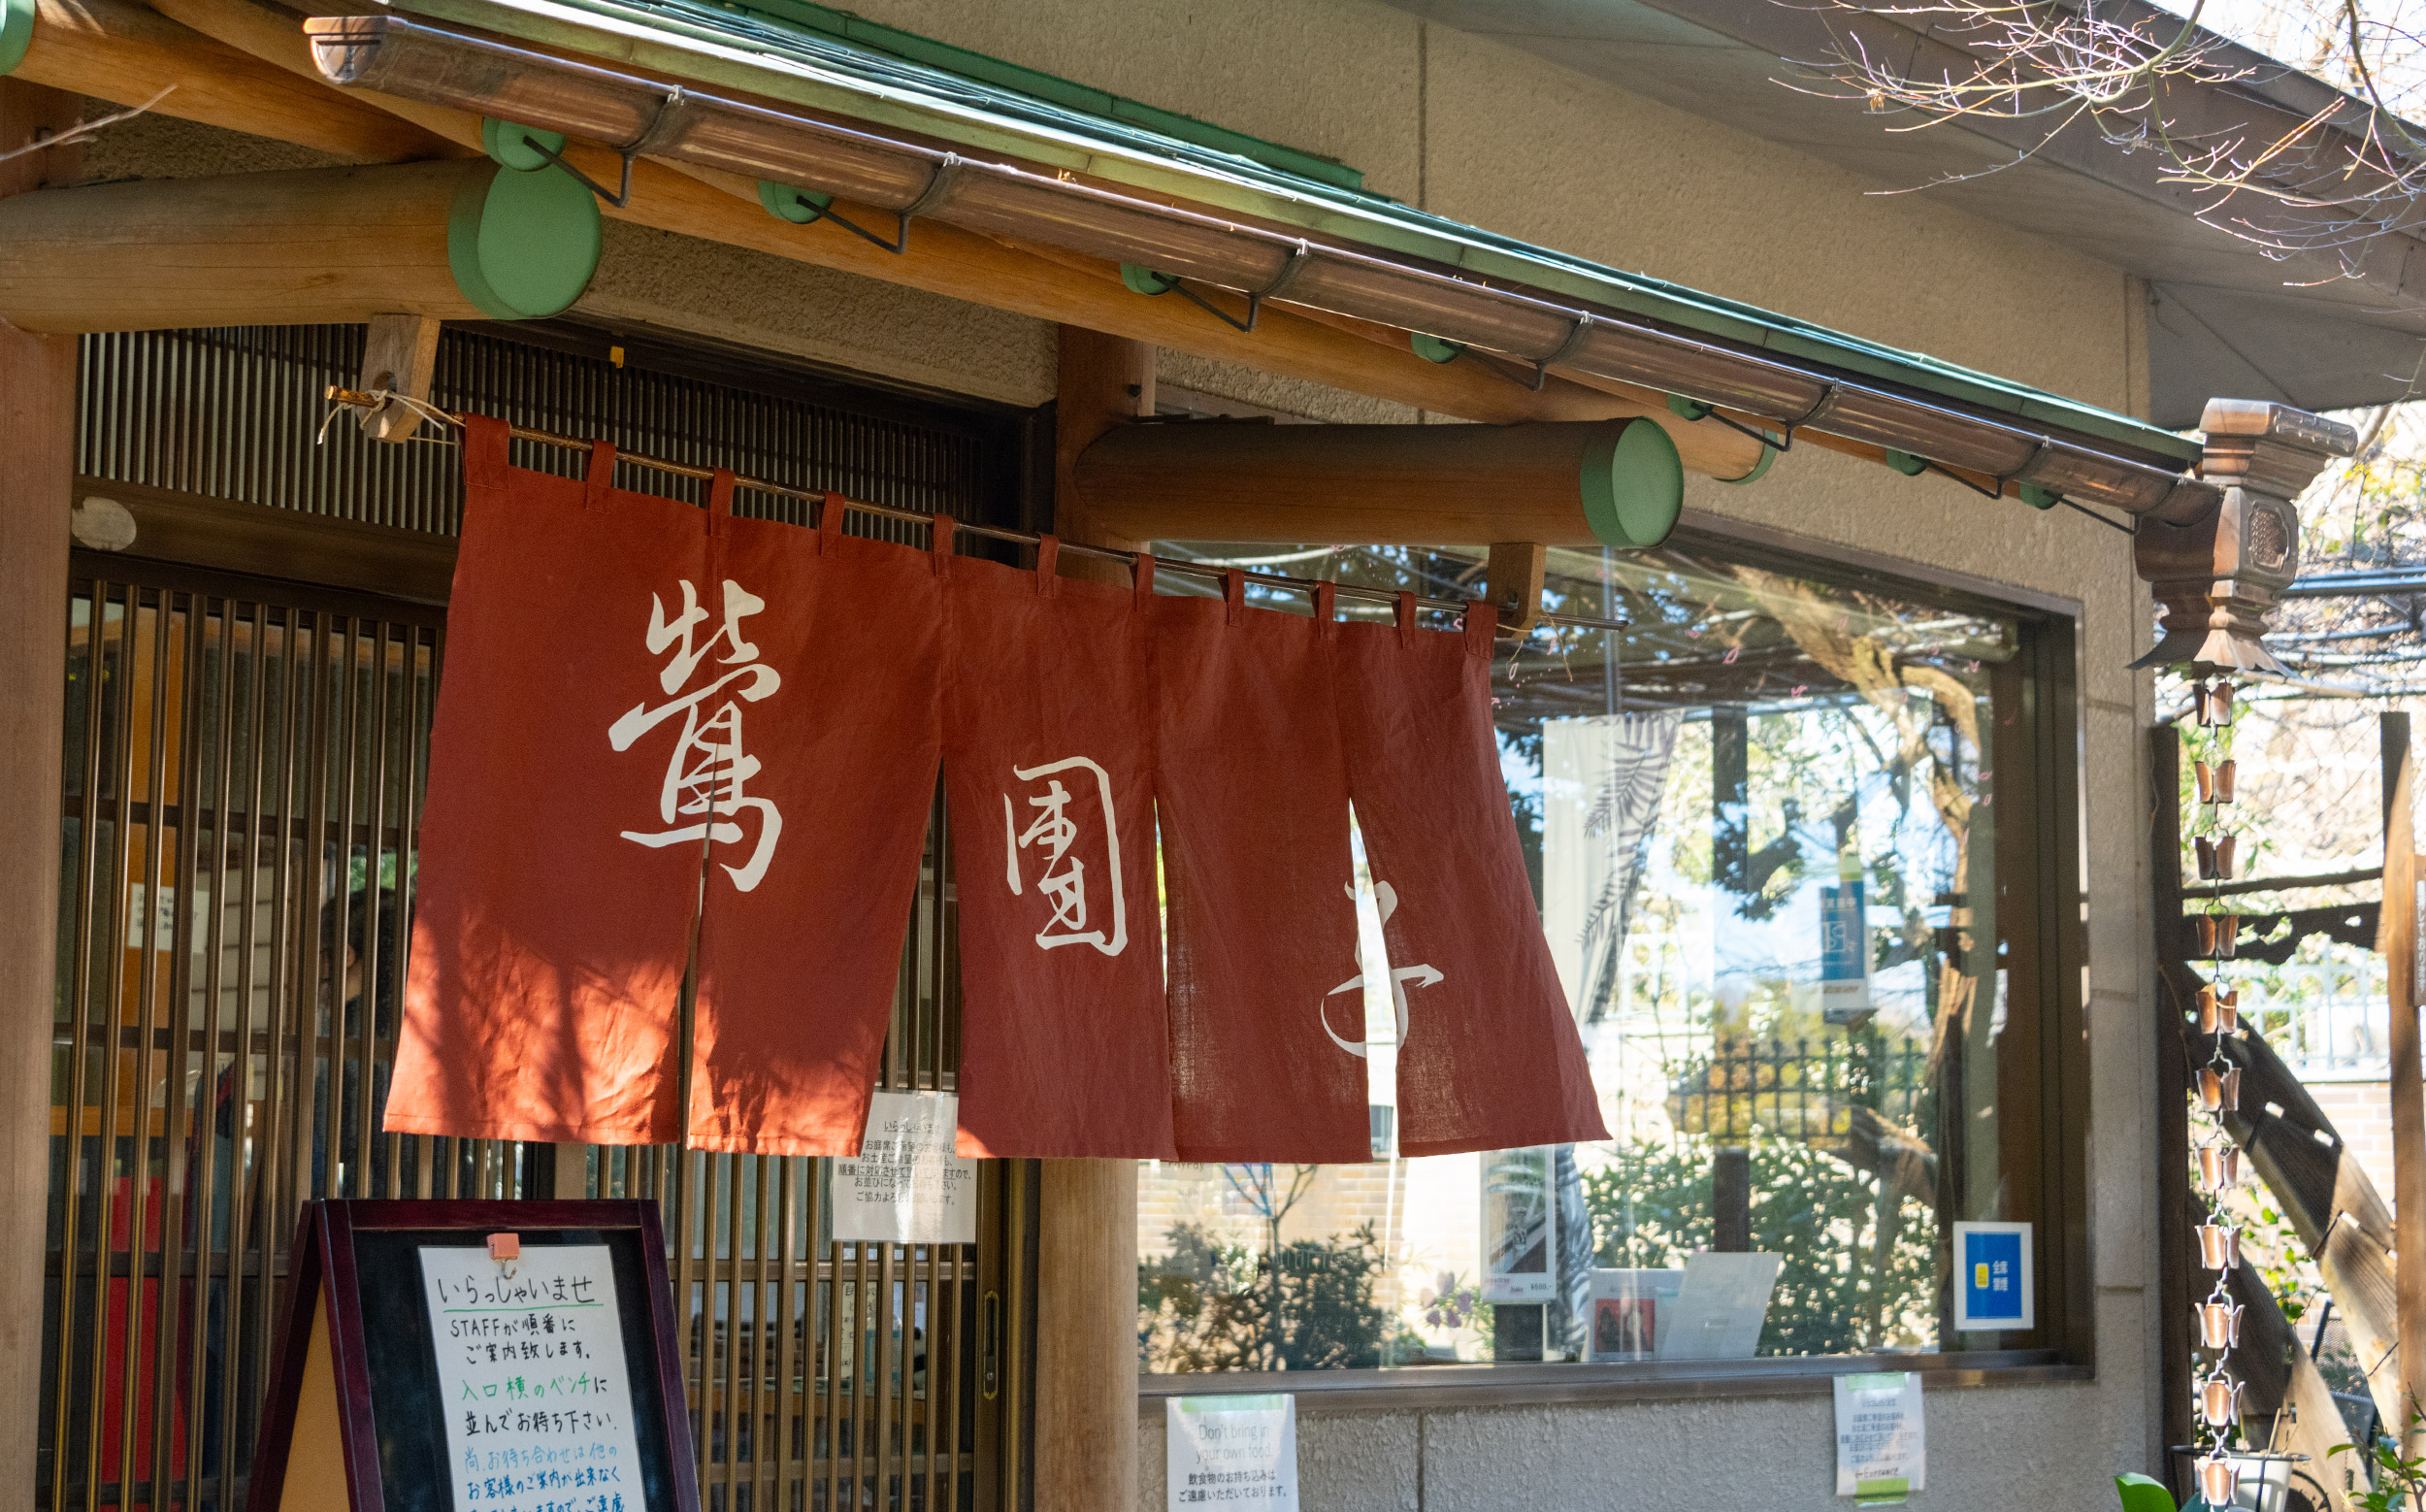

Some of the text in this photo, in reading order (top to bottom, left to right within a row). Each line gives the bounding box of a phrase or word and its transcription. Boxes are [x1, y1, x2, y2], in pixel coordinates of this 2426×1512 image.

[438, 1274, 596, 1305] いらっしゃいませ
[449, 1313, 576, 1338] STAFFが順番に
[461, 1371, 608, 1401] 入口横のベンチに
[1198, 1424, 1229, 1440] Don't
[1230, 1423, 1258, 1441] bring
[1196, 1448, 1221, 1464] your
[1223, 1447, 1246, 1460] own
[1188, 1469, 1276, 1486] 飲食物のお持ち込みは
[1178, 1484, 1288, 1503] ご遠慮いただいております。
